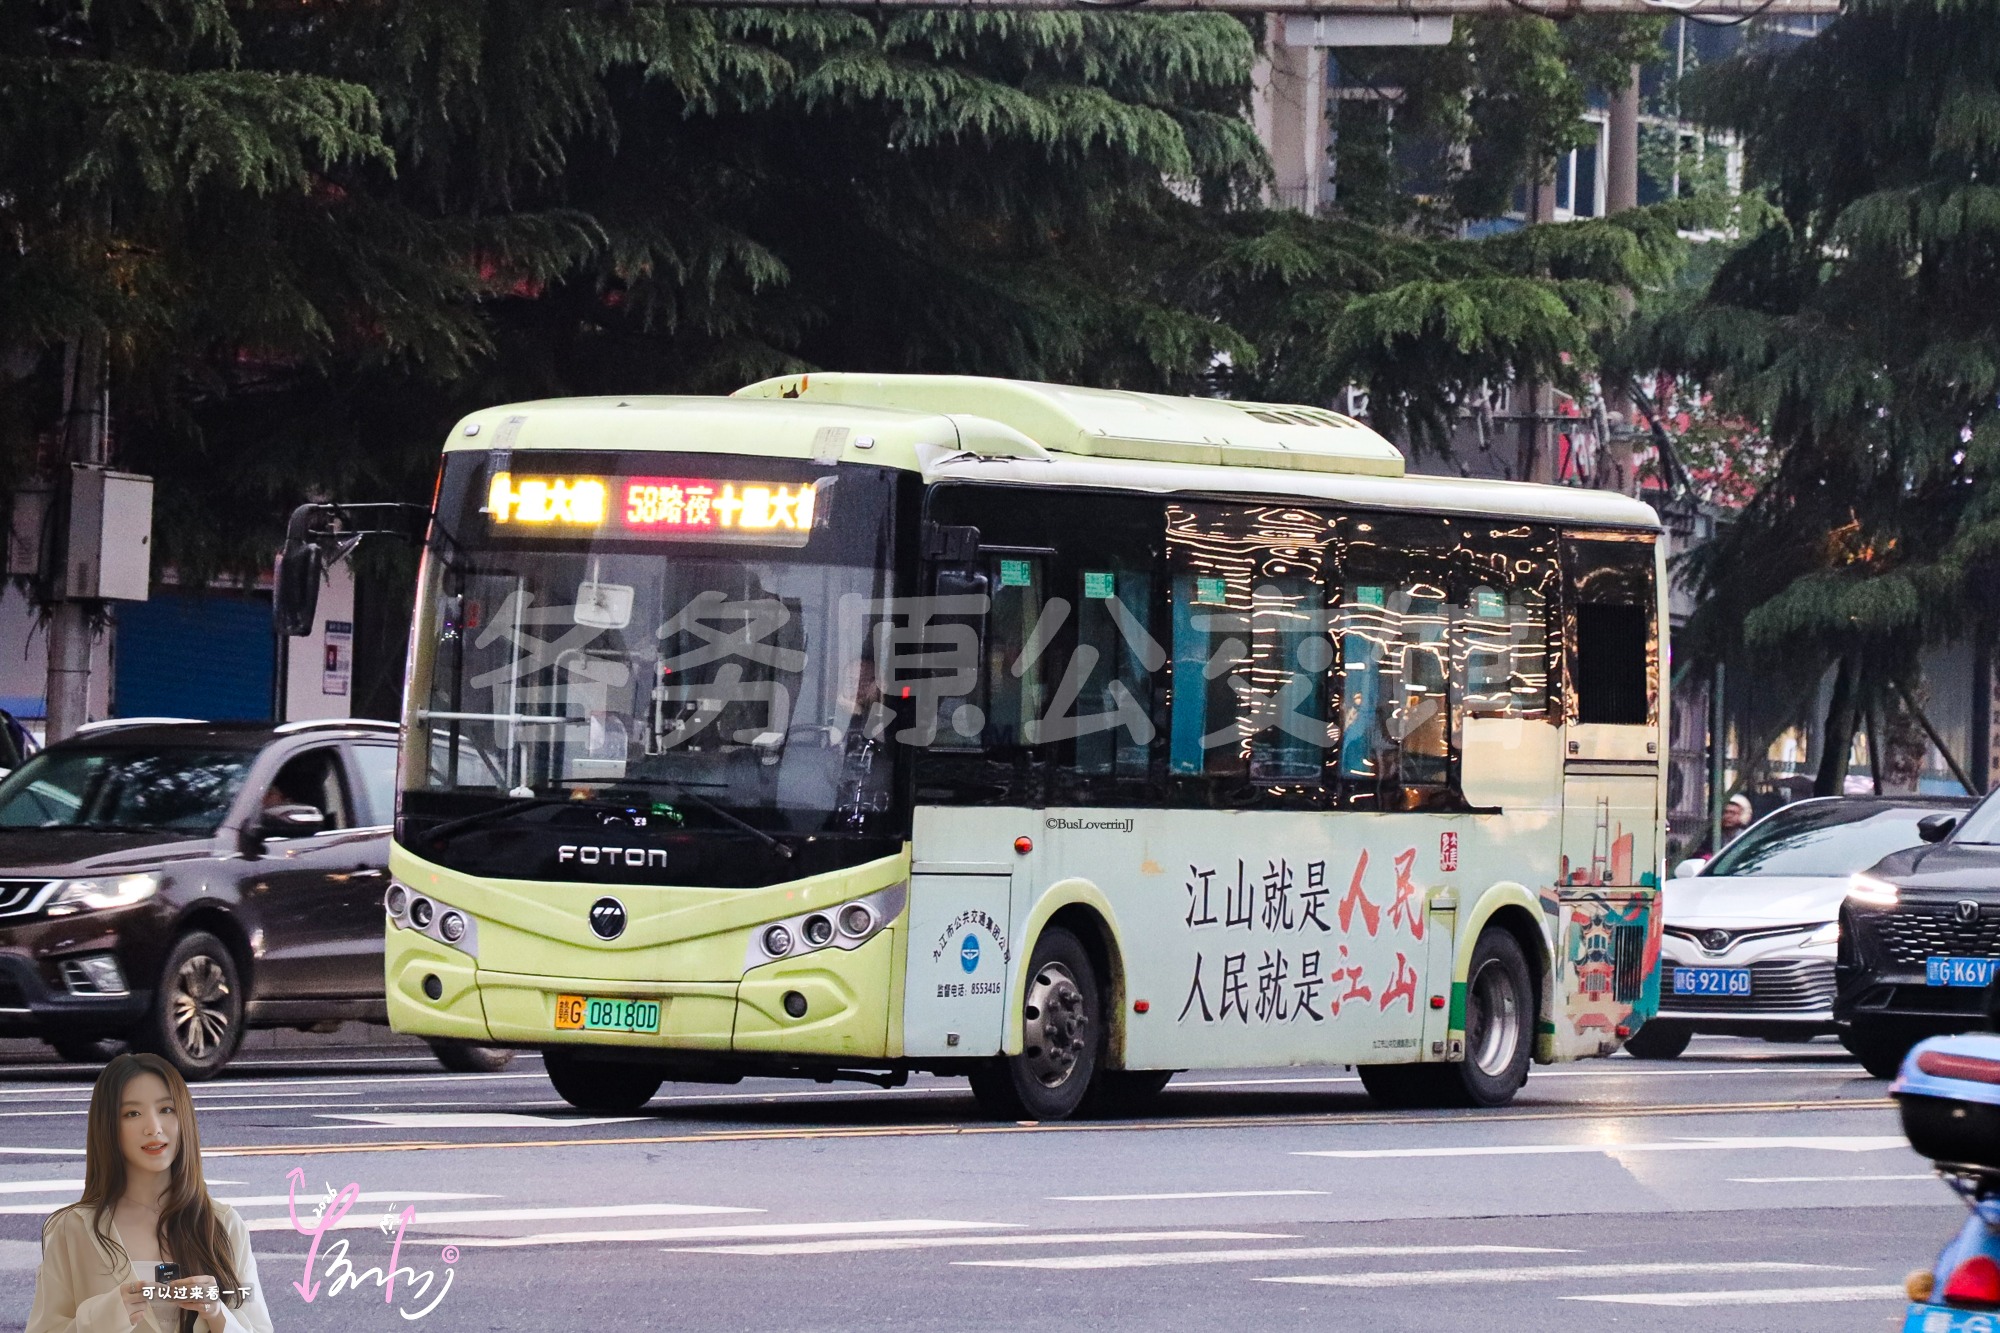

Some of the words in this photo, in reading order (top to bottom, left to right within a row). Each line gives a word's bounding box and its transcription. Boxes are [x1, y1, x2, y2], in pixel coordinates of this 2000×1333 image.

[558, 845, 667, 867] FOTON
[1185, 848, 1425, 940] 江山就是人民
[971, 983, 1001, 995] 8553416
[1177, 945, 1418, 1024] 人民就是江山
